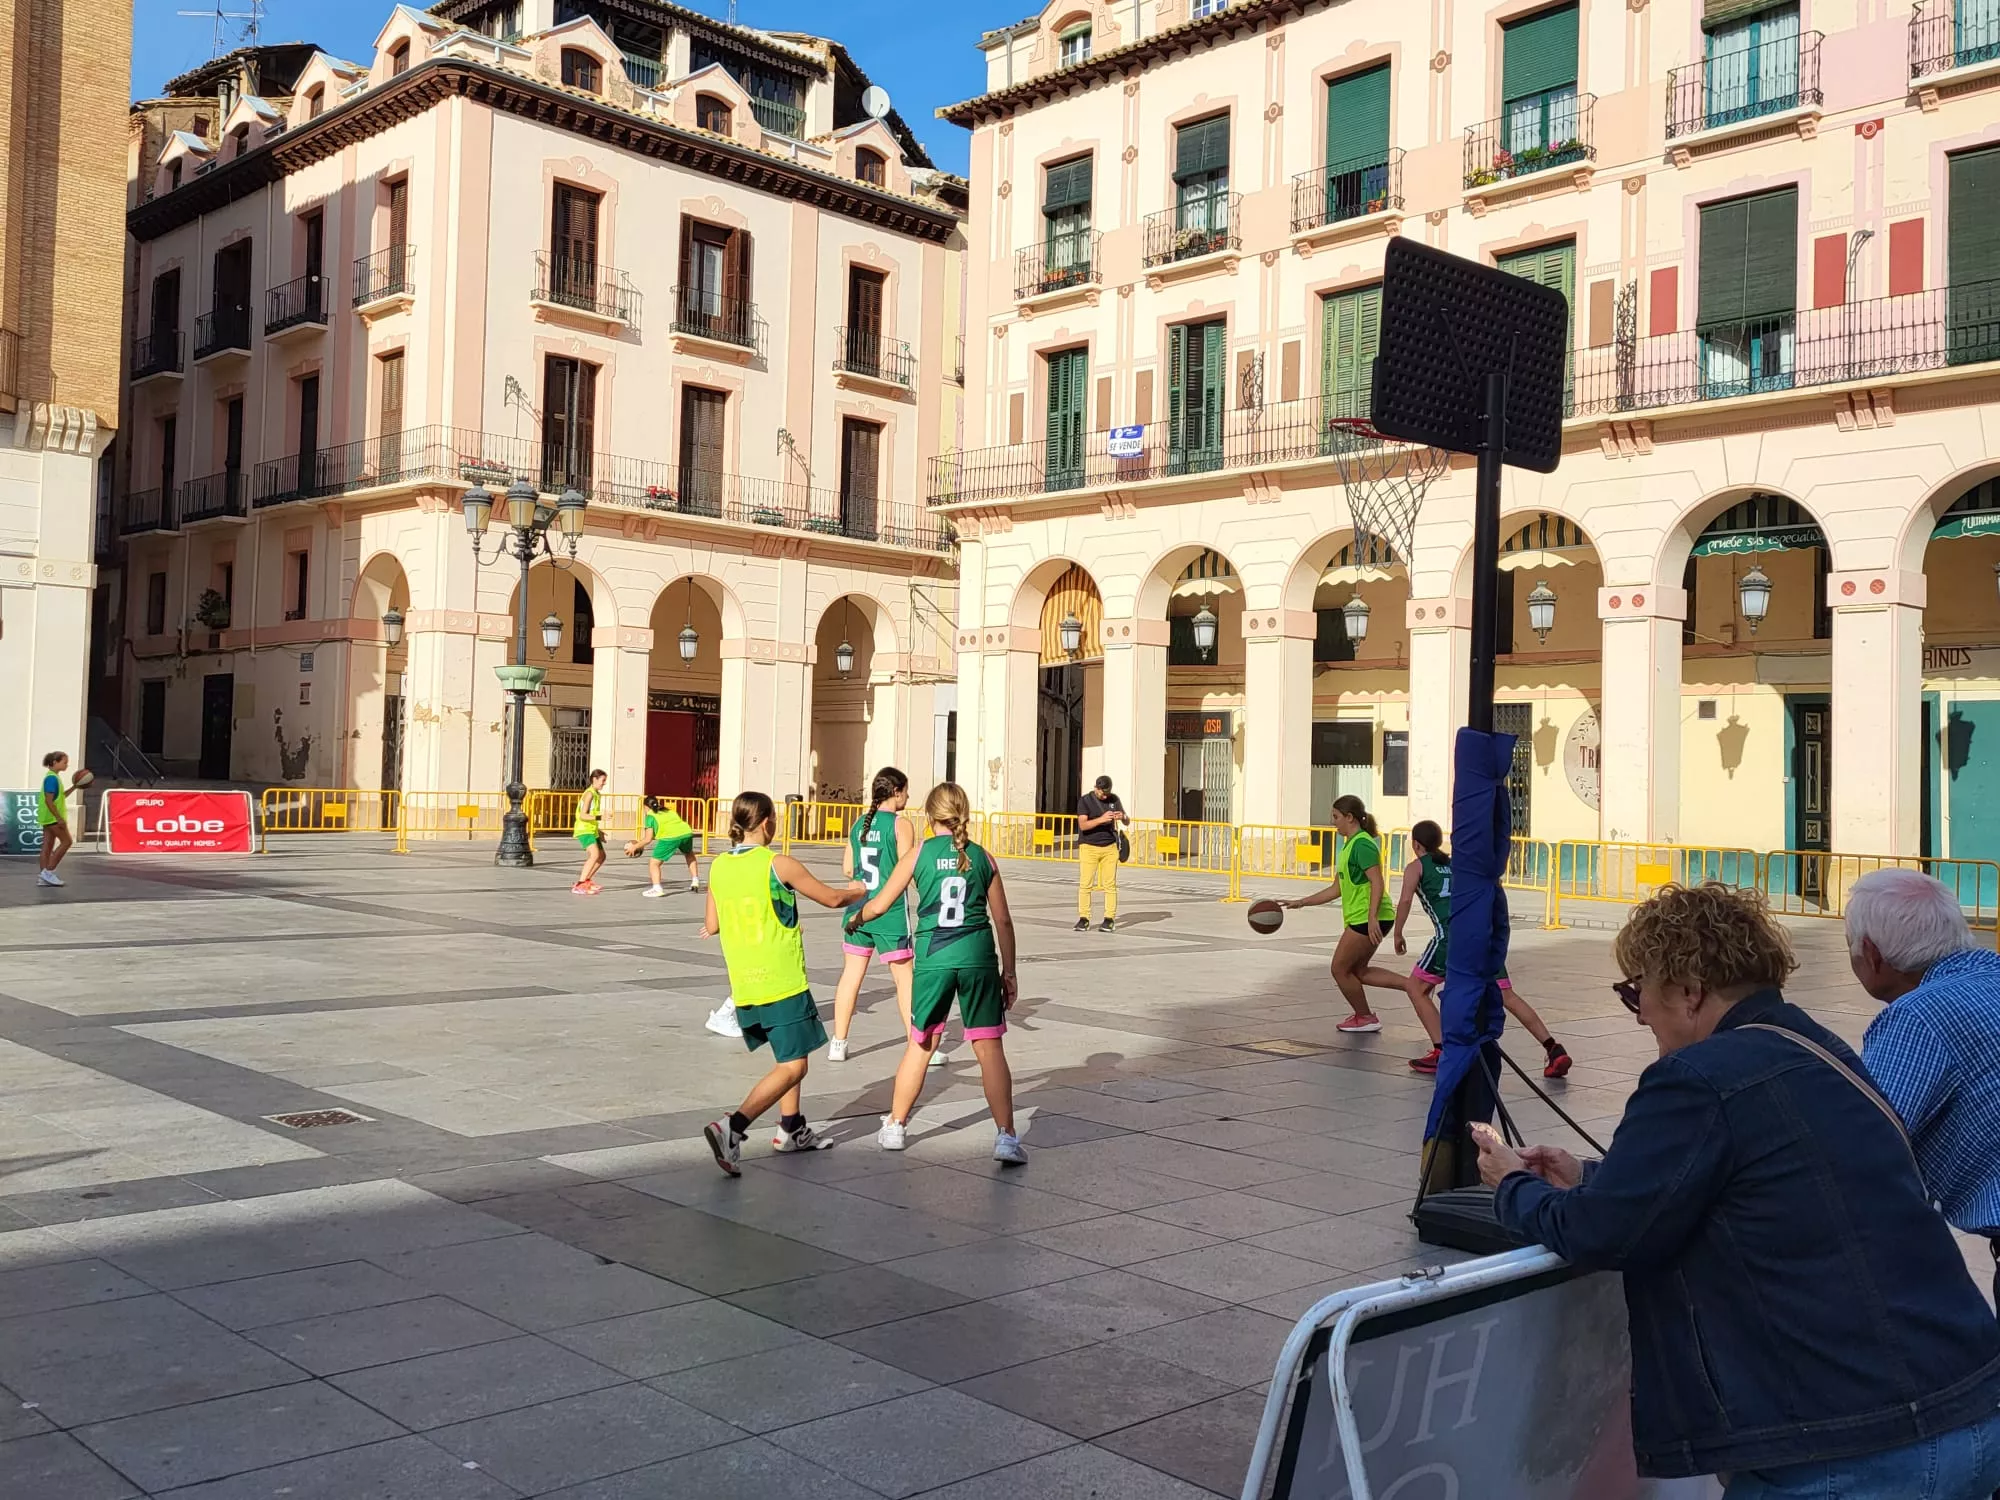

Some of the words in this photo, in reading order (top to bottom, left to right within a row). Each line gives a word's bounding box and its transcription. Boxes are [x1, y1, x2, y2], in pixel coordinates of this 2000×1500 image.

[1119, 440, 1141, 450] VENDE
[136, 799, 164, 807] GRUPO
[136, 815, 225, 833] Lobe
[860, 847, 879, 890] 5
[938, 876, 967, 927] 8
